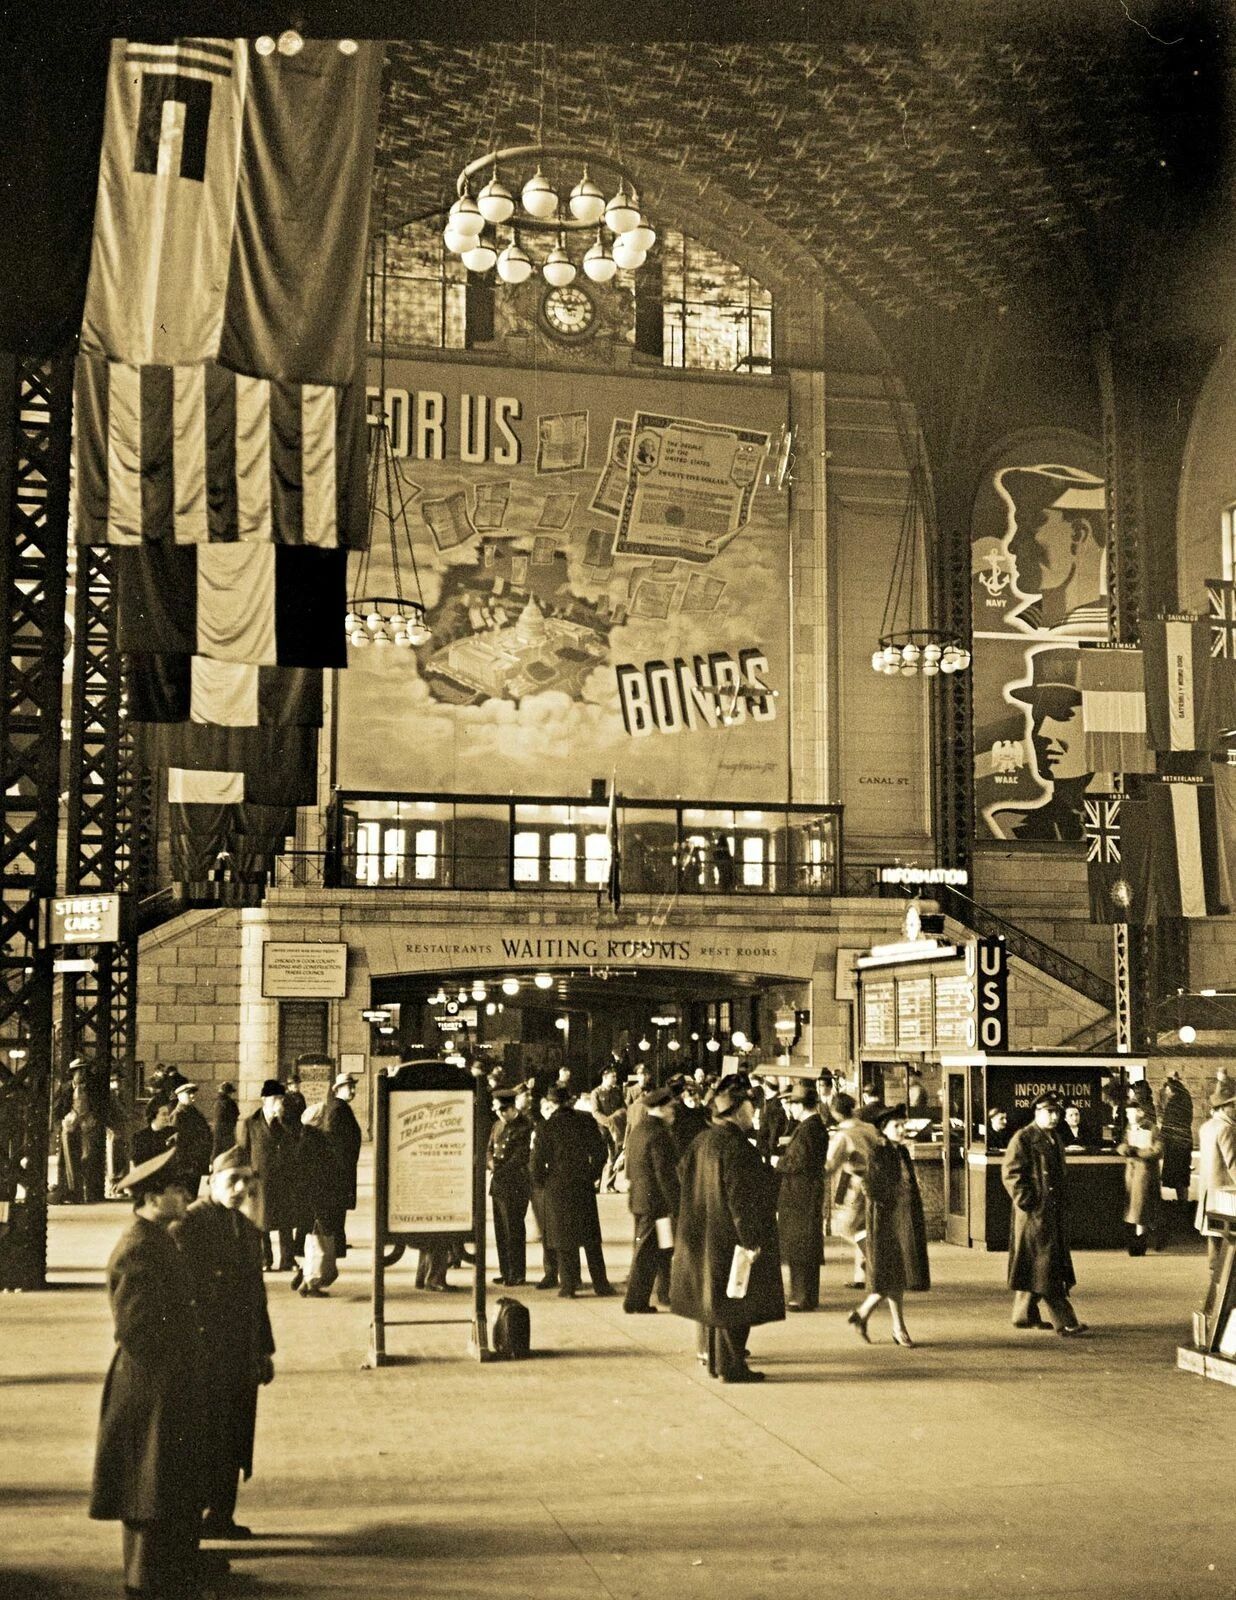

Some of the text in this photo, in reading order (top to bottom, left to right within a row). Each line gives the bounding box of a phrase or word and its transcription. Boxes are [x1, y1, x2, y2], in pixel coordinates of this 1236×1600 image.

[460, 393, 521, 465] US
[664, 455, 710, 467] UNITED STATES
[985, 599, 1007, 608] NAVY
[1168, 614, 1198, 622] SALVADOR
[617, 649, 776, 737] BONDS
[859, 776, 894, 785] CANAL
[994, 775, 1019, 784] WAAC
[1162, 775, 1204, 783] NETHERLANDS
[881, 867, 968, 885] INFORMATION
[55, 898, 110, 915] STREET
[64, 916, 102, 931] CARS
[406, 938, 778, 961] RESTAURANTS WAITING ROOMS REST ROOMS
[981, 946, 1001, 1047] USO
[1014, 1083, 1091, 1096] INFORMATION
[1015, 1099, 1030, 1108] FOR
[1071, 1098, 1092, 1108] MEN
[403, 1106, 453, 1126] WAR TIME
[400, 1116, 463, 1141] TRAFFIC CODE
